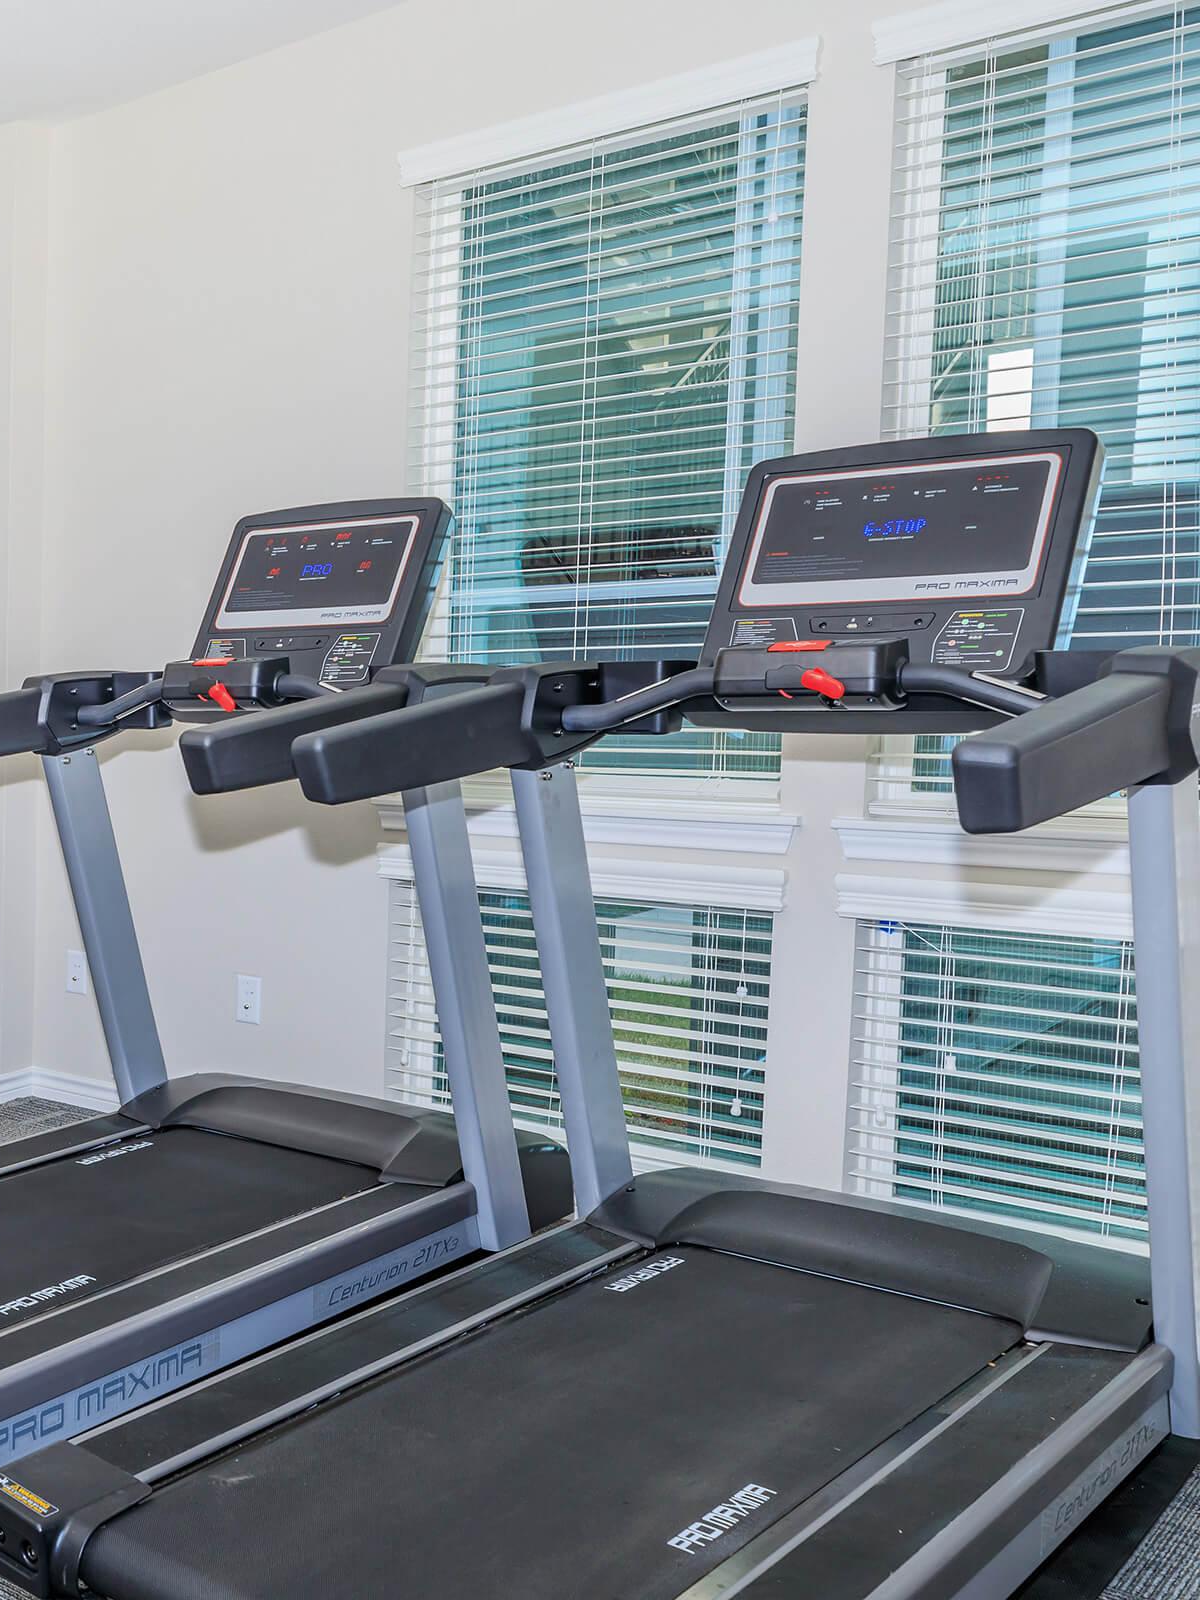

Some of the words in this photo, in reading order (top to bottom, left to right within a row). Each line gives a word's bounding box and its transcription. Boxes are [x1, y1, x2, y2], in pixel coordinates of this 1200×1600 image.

[302, 563, 333, 577] PRO
[914, 582, 951, 591] PRO
[954, 578, 1019, 589] MAXIMA
[328, 1260, 409, 1307] Centurion
[412, 1235, 460, 1269] 21TX3
[645, 1255, 686, 1272] PRO
[30, 1274, 97, 1302] MAXIMA
[603, 1267, 662, 1293] MAXIMA
[76, 1342, 202, 1422] MAXIMA
[1054, 1459, 1118, 1533] Centurion
[666, 1521, 725, 1556] PRO
[701, 1483, 778, 1530] MAXIMA
